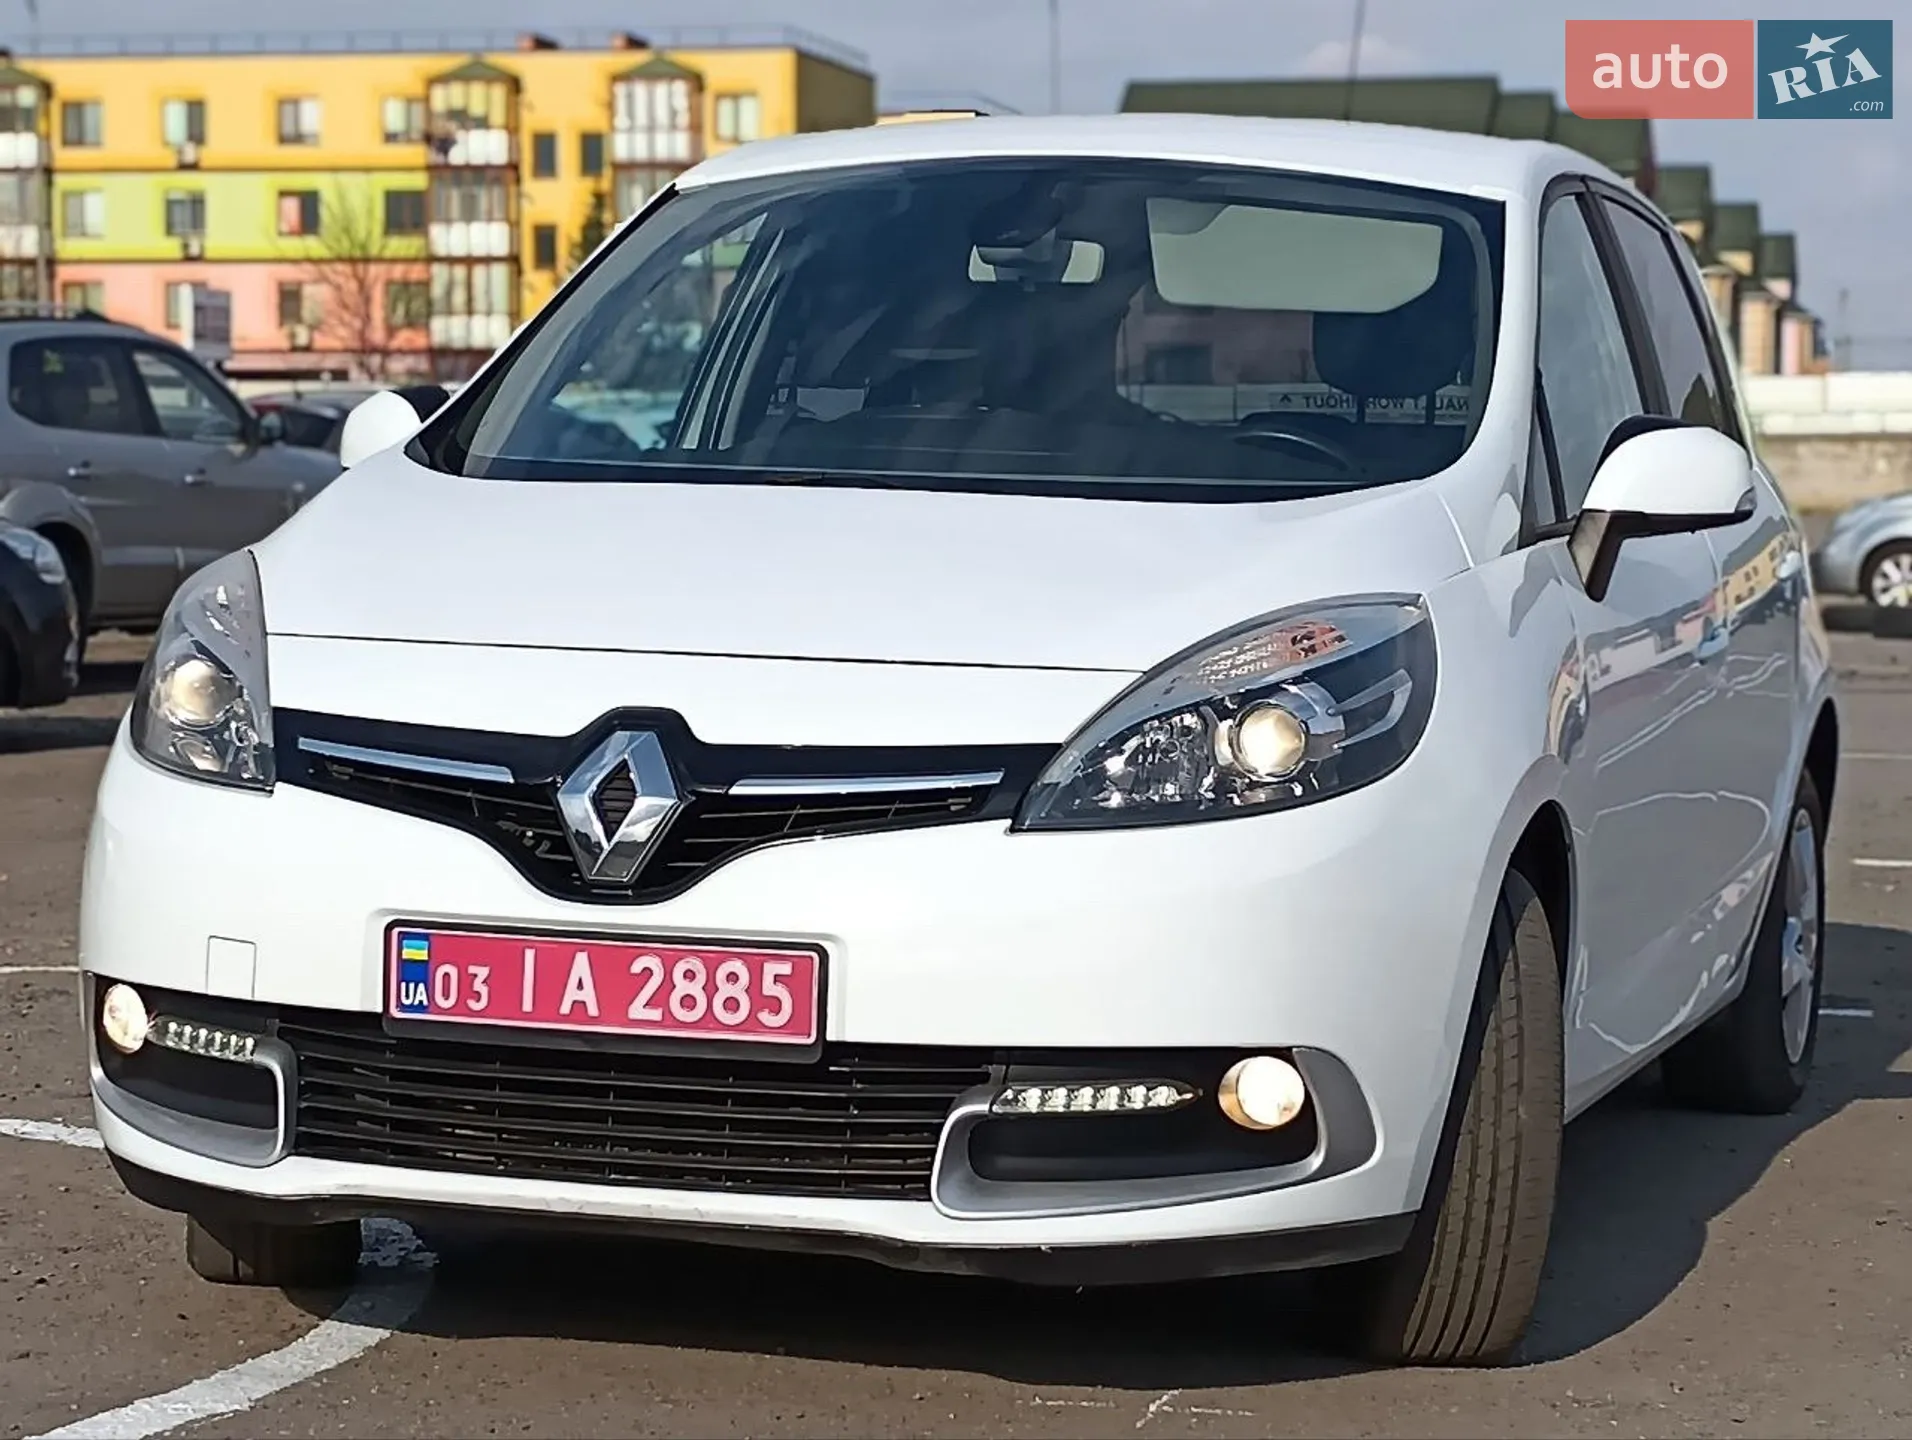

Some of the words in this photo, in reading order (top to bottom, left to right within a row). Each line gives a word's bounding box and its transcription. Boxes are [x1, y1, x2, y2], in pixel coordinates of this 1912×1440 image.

[400, 981, 429, 1007] UA
[434, 963, 491, 1012] 03
[627, 953, 794, 1029] 2885
